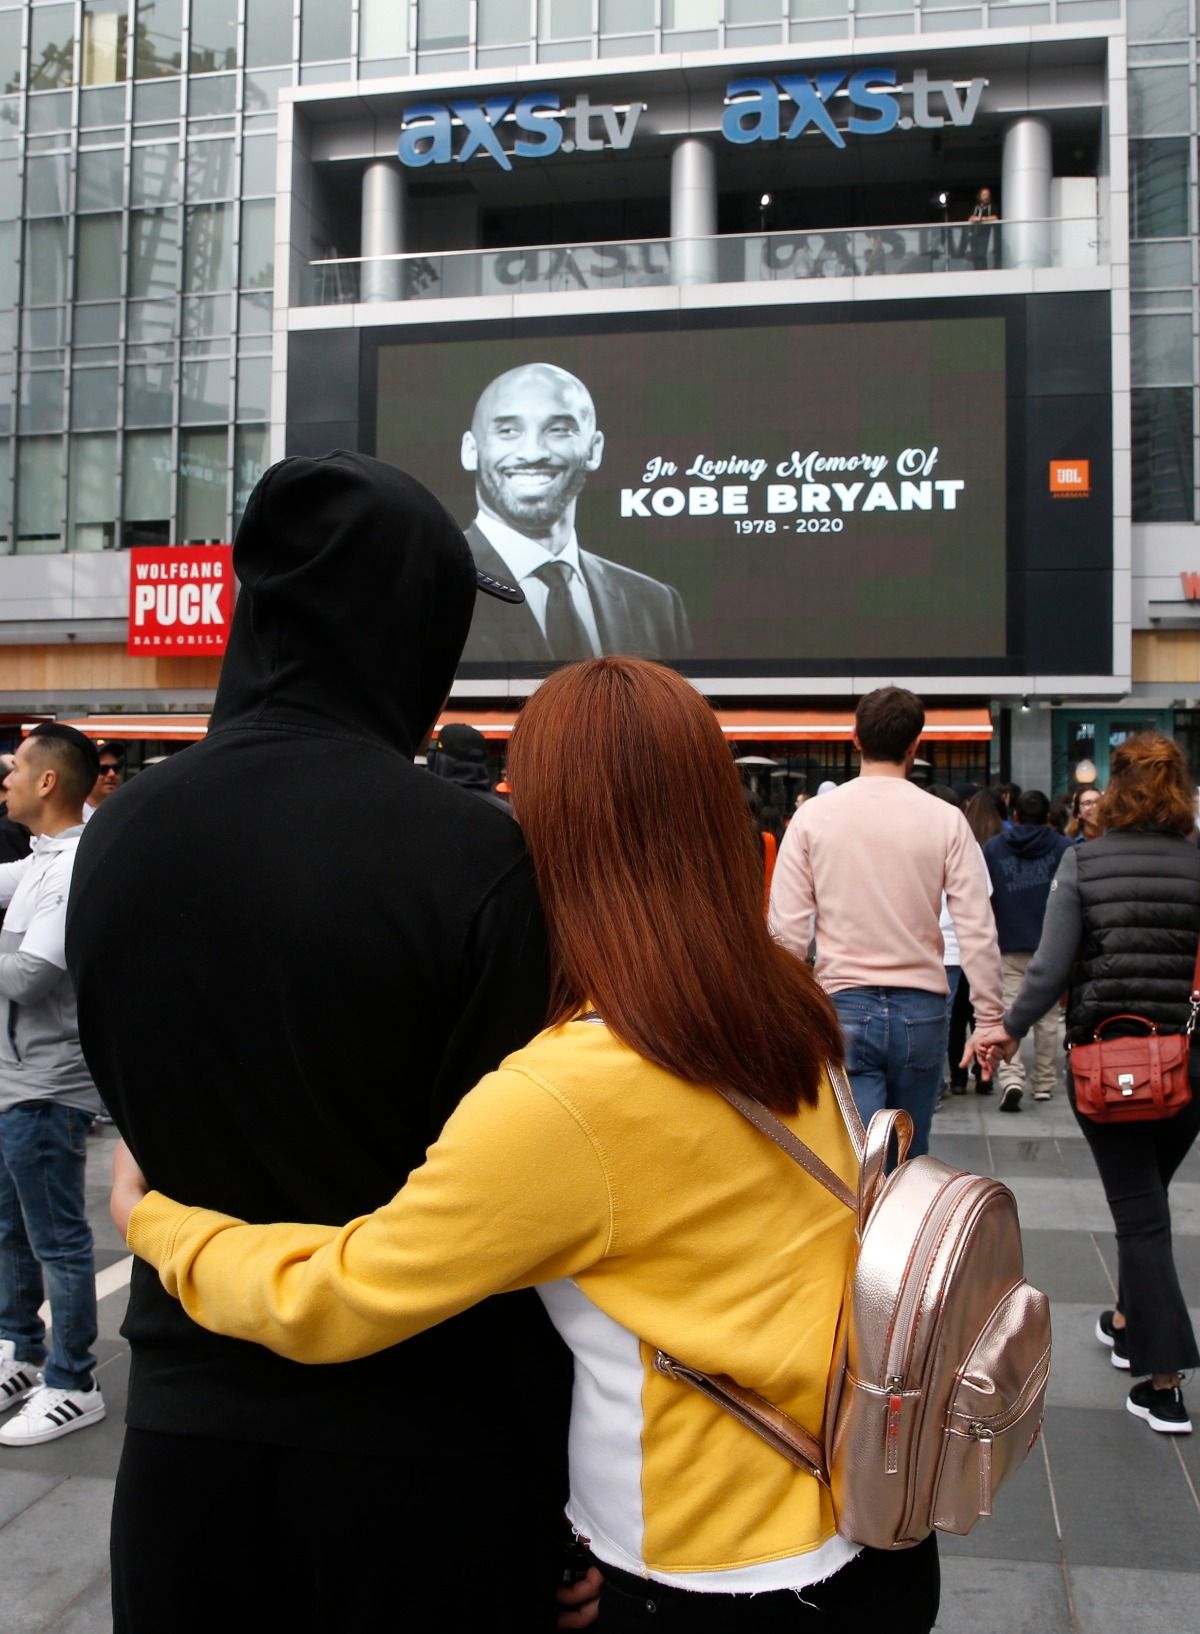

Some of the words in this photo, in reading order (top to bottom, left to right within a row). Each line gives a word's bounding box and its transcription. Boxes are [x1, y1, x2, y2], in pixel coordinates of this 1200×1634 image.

[721, 67, 986, 148] axs.tv
[398, 92, 643, 171] axs.tv
[642, 456, 677, 483] In
[686, 454, 768, 482] Loving
[776, 451, 888, 482] Memory
[897, 446, 939, 477] Of
[1056, 468, 1083, 484] JBL
[620, 485, 749, 517] KOBE
[767, 480, 965, 514] BRYANT
[734, 519, 777, 534] 1978
[796, 517, 844, 533] 2020
[136, 562, 222, 579] WOLFGANG
[135, 583, 224, 626] PUCK
